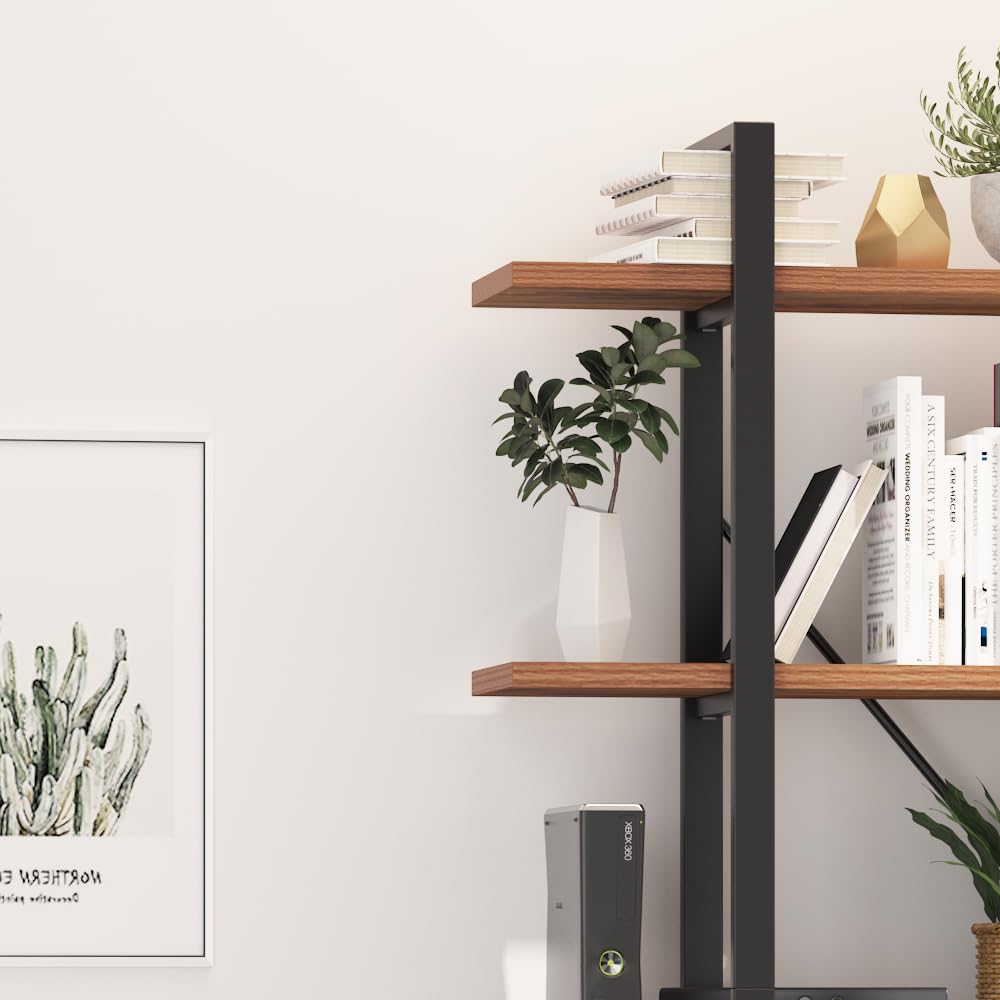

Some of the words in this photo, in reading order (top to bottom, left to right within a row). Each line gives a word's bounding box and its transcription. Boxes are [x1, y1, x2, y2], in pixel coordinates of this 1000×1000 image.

[927, 403, 936, 413] A
[927, 415, 936, 437] SIX
[927, 439, 936, 505] CENTURY
[927, 508, 936, 559] FAMILY
[624, 821, 633, 844] XBOX
[624, 844, 633, 861] 360
